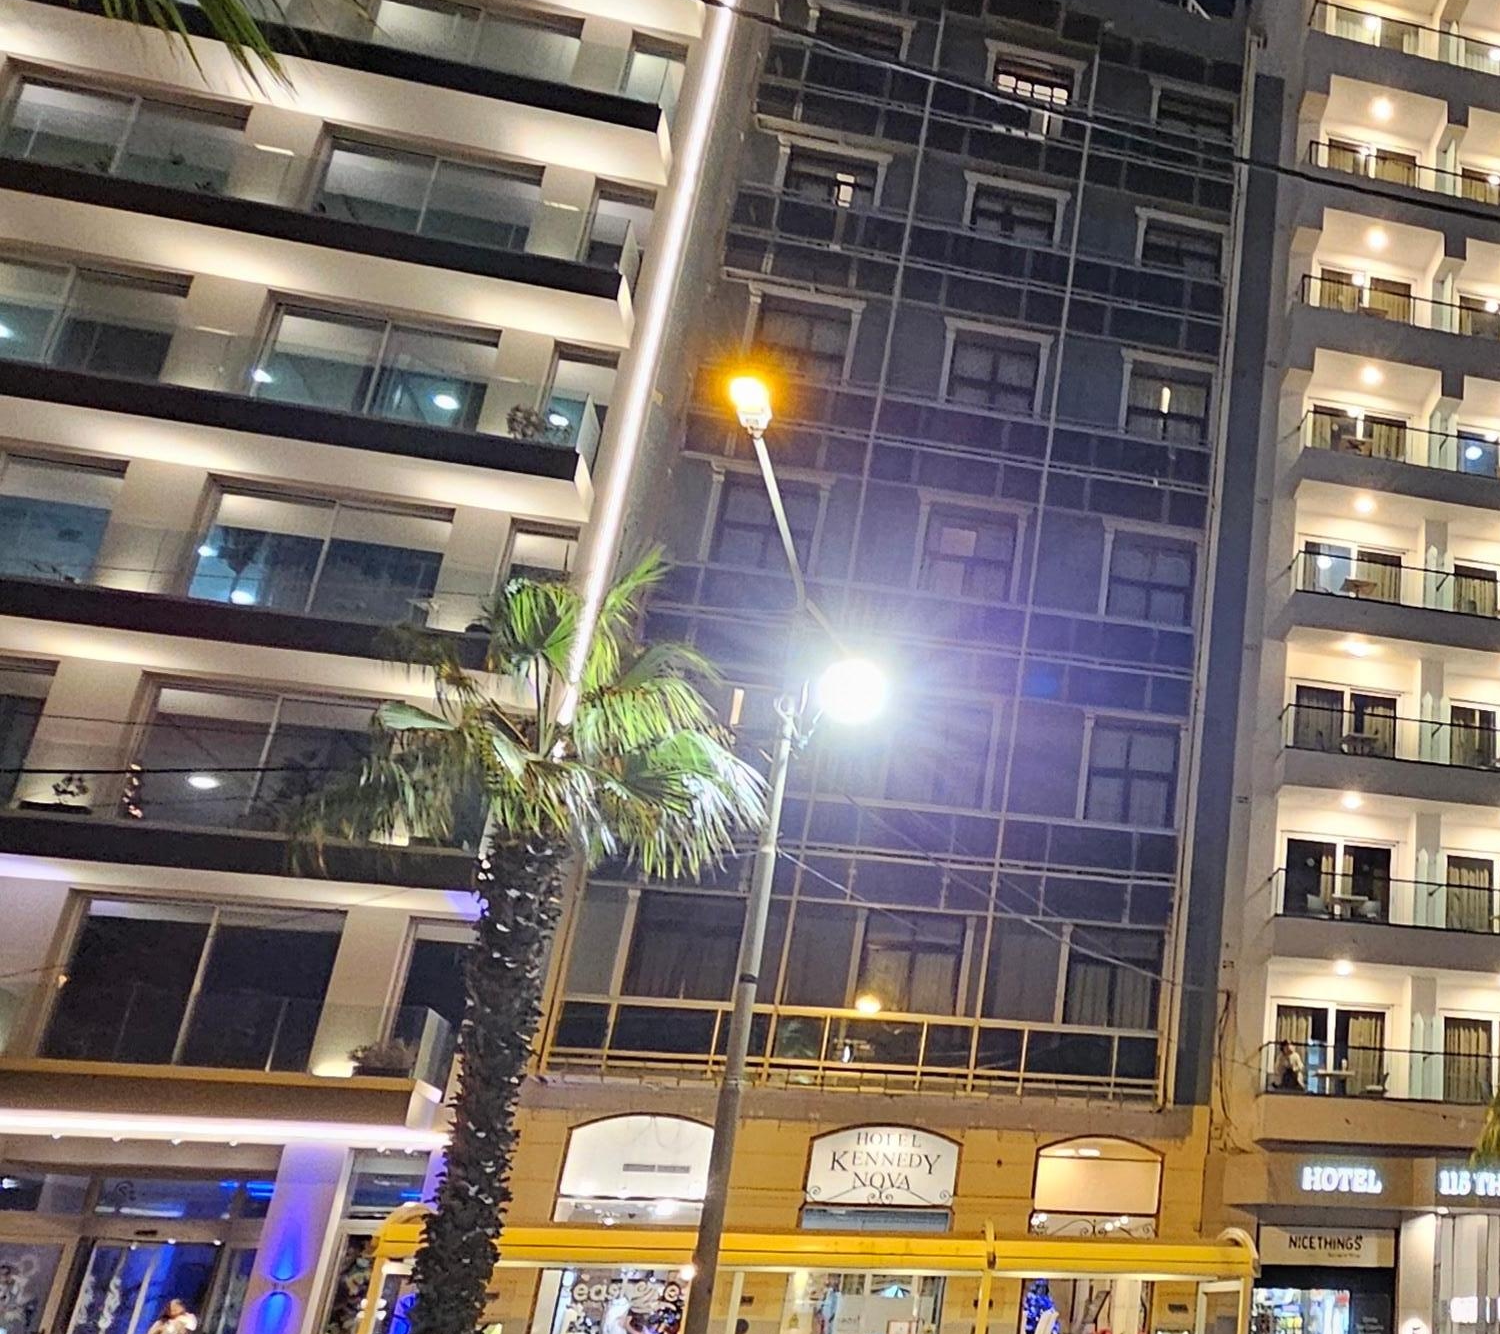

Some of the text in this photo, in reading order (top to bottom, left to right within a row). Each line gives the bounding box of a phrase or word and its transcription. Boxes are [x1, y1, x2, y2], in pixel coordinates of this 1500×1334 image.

[856, 1132, 922, 1149] HOTEL
[830, 1150, 941, 1175] KENNEDY
[852, 1171, 911, 1191] NOVA
[1301, 1166, 1383, 1194] HOTEL
